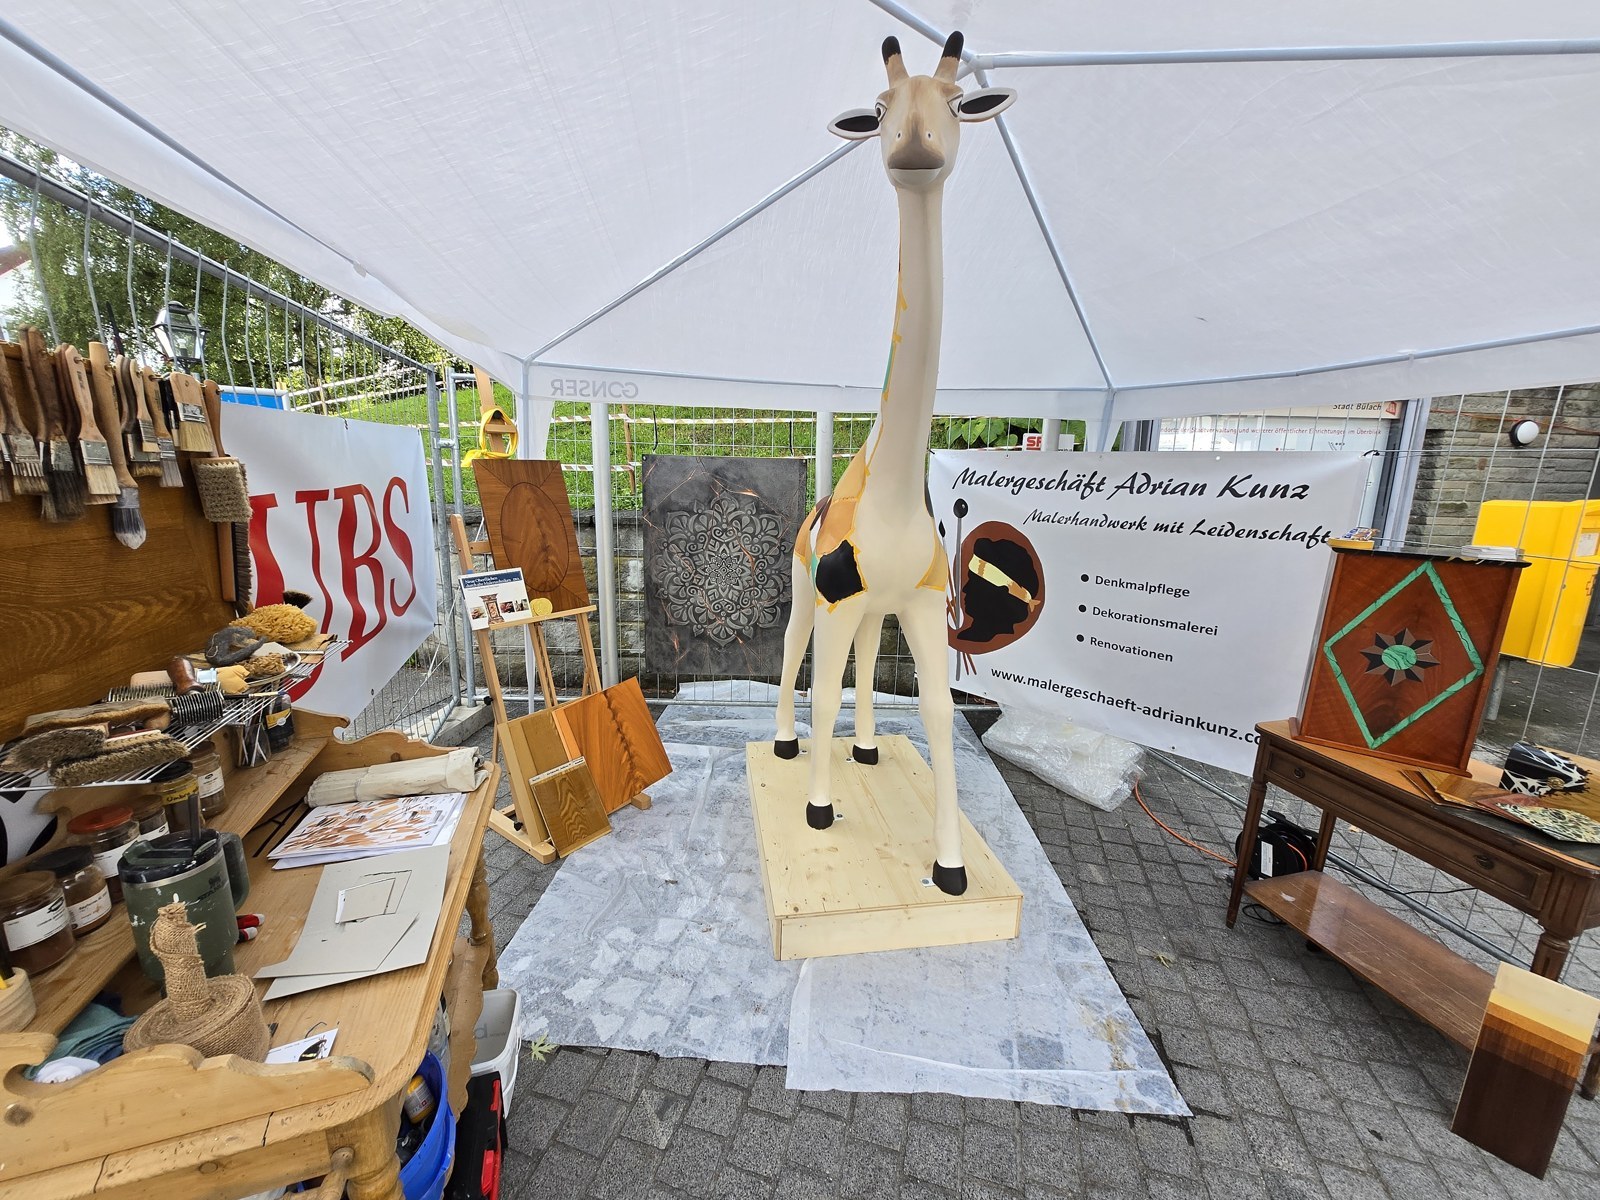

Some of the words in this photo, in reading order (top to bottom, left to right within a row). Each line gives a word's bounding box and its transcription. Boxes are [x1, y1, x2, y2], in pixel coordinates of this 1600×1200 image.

[1355, 402, 1382, 411] Bülach
[951, 467, 1107, 501] Malergeschäft
[1106, 471, 1207, 501] Adrian
[1217, 473, 1310, 500] Kunz
[1023, 508, 1148, 531] Malerhandwerk
[1153, 516, 1185, 534] mit
[1189, 518, 1331, 550] Leidenschaft
[1095, 575, 1191, 599] Denkmalpflege
[1092, 606, 1218, 636] Dekorationsmalerei
[1090, 636, 1173, 663] Renovationen
